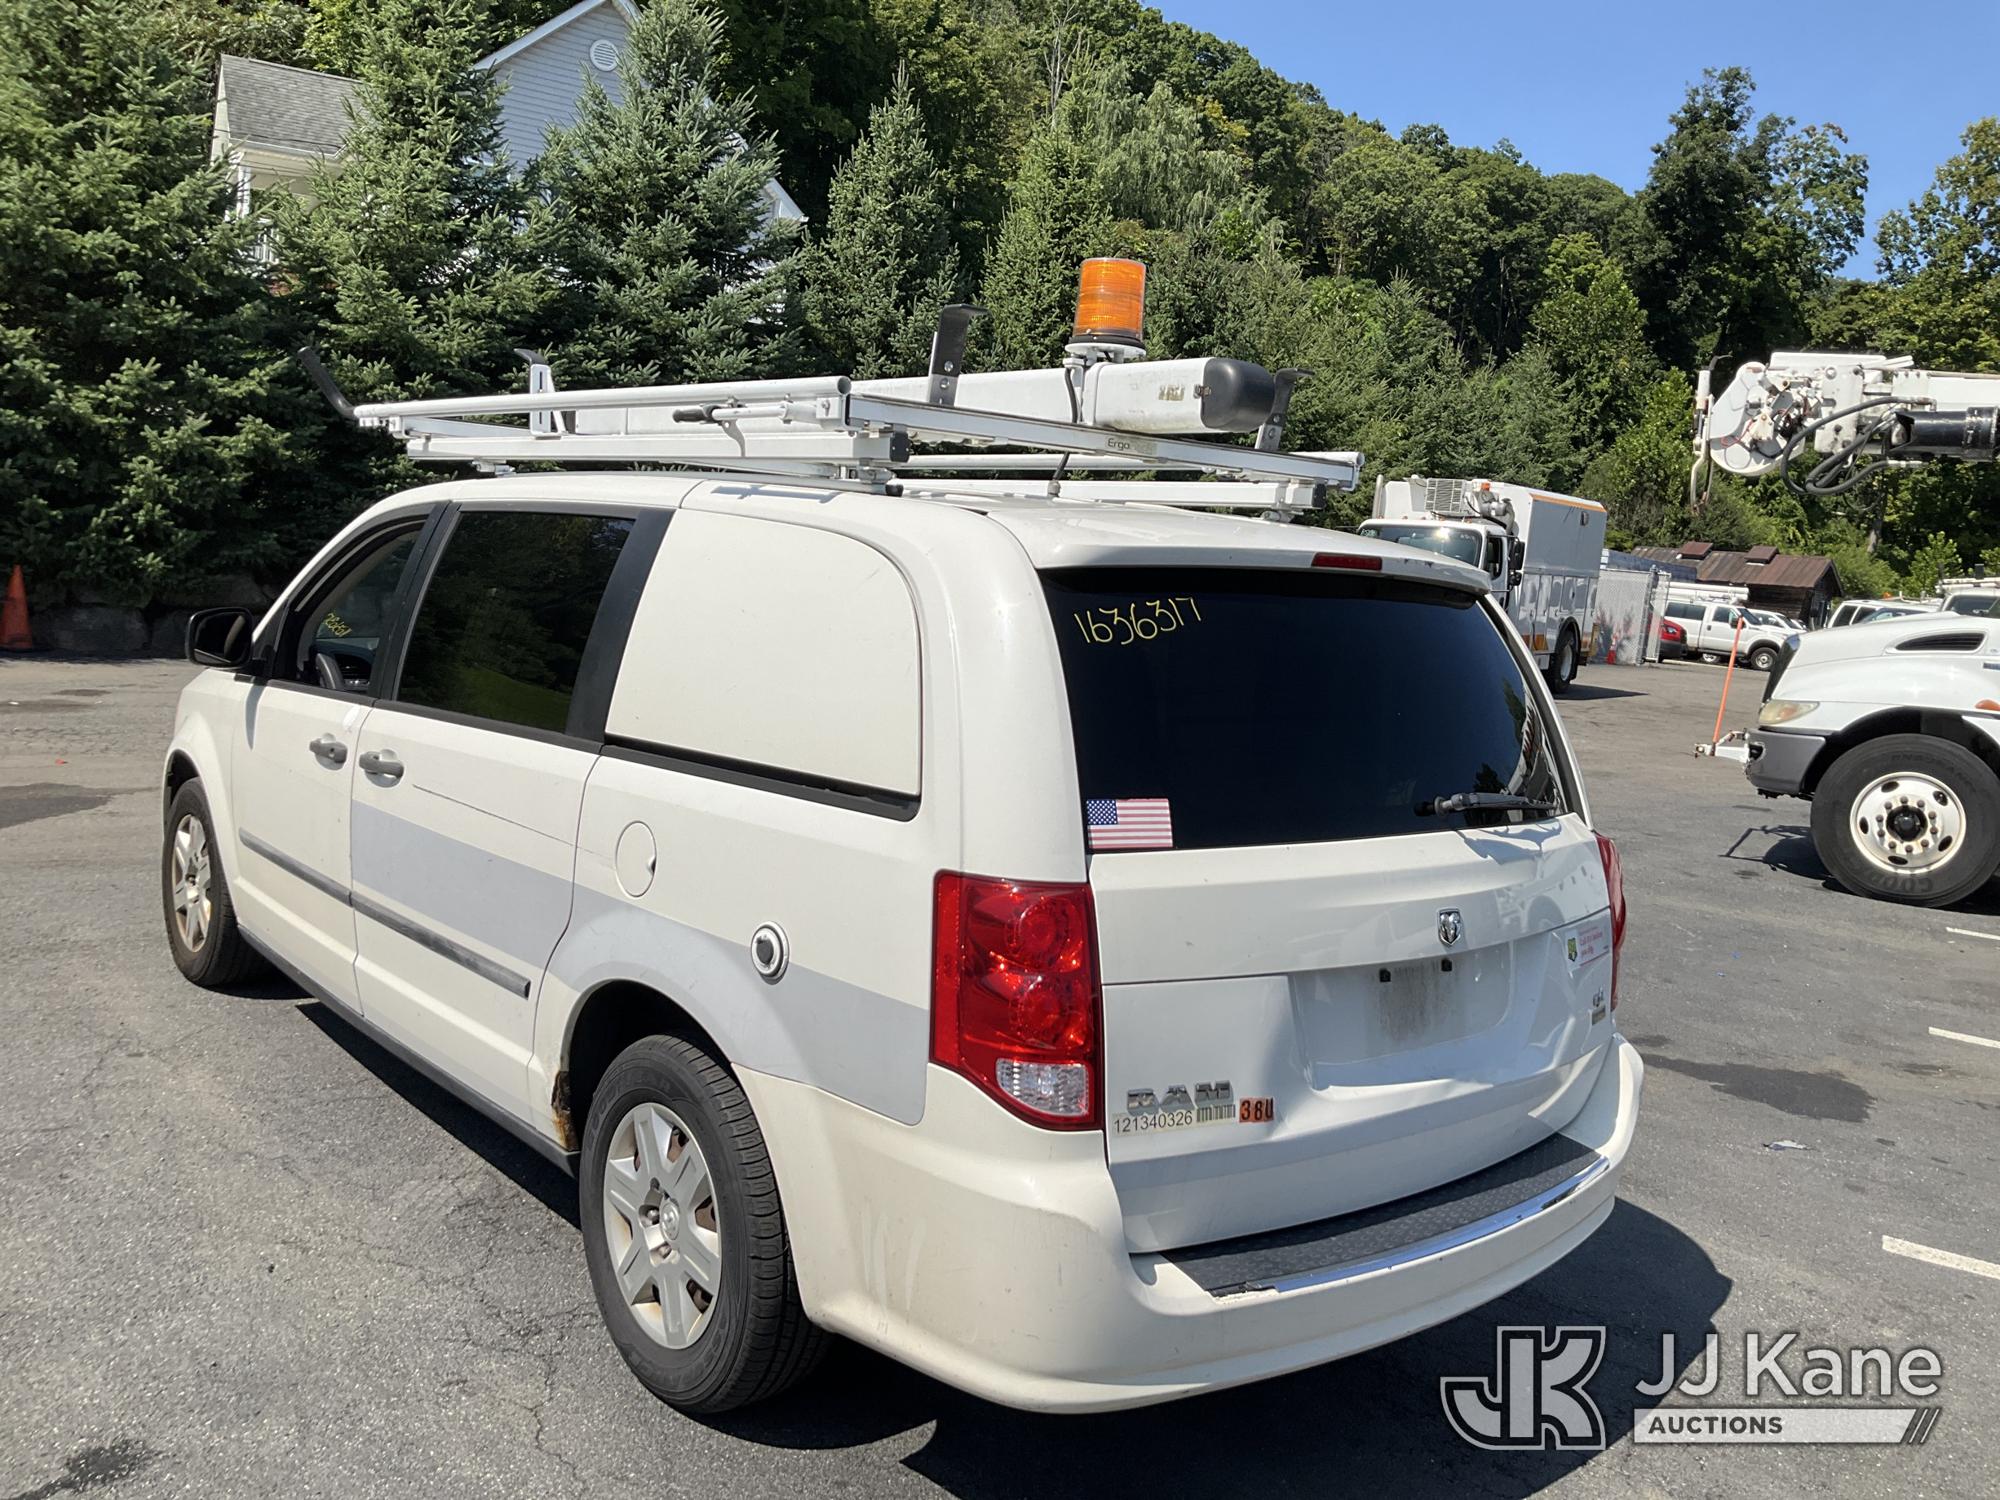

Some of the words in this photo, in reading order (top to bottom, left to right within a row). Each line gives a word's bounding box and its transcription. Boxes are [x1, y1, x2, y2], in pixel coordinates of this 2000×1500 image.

[1073, 597, 1202, 646] 1636317
[1127, 1080, 1234, 1116] RAM
[1114, 1111, 1193, 1134] 121340326
